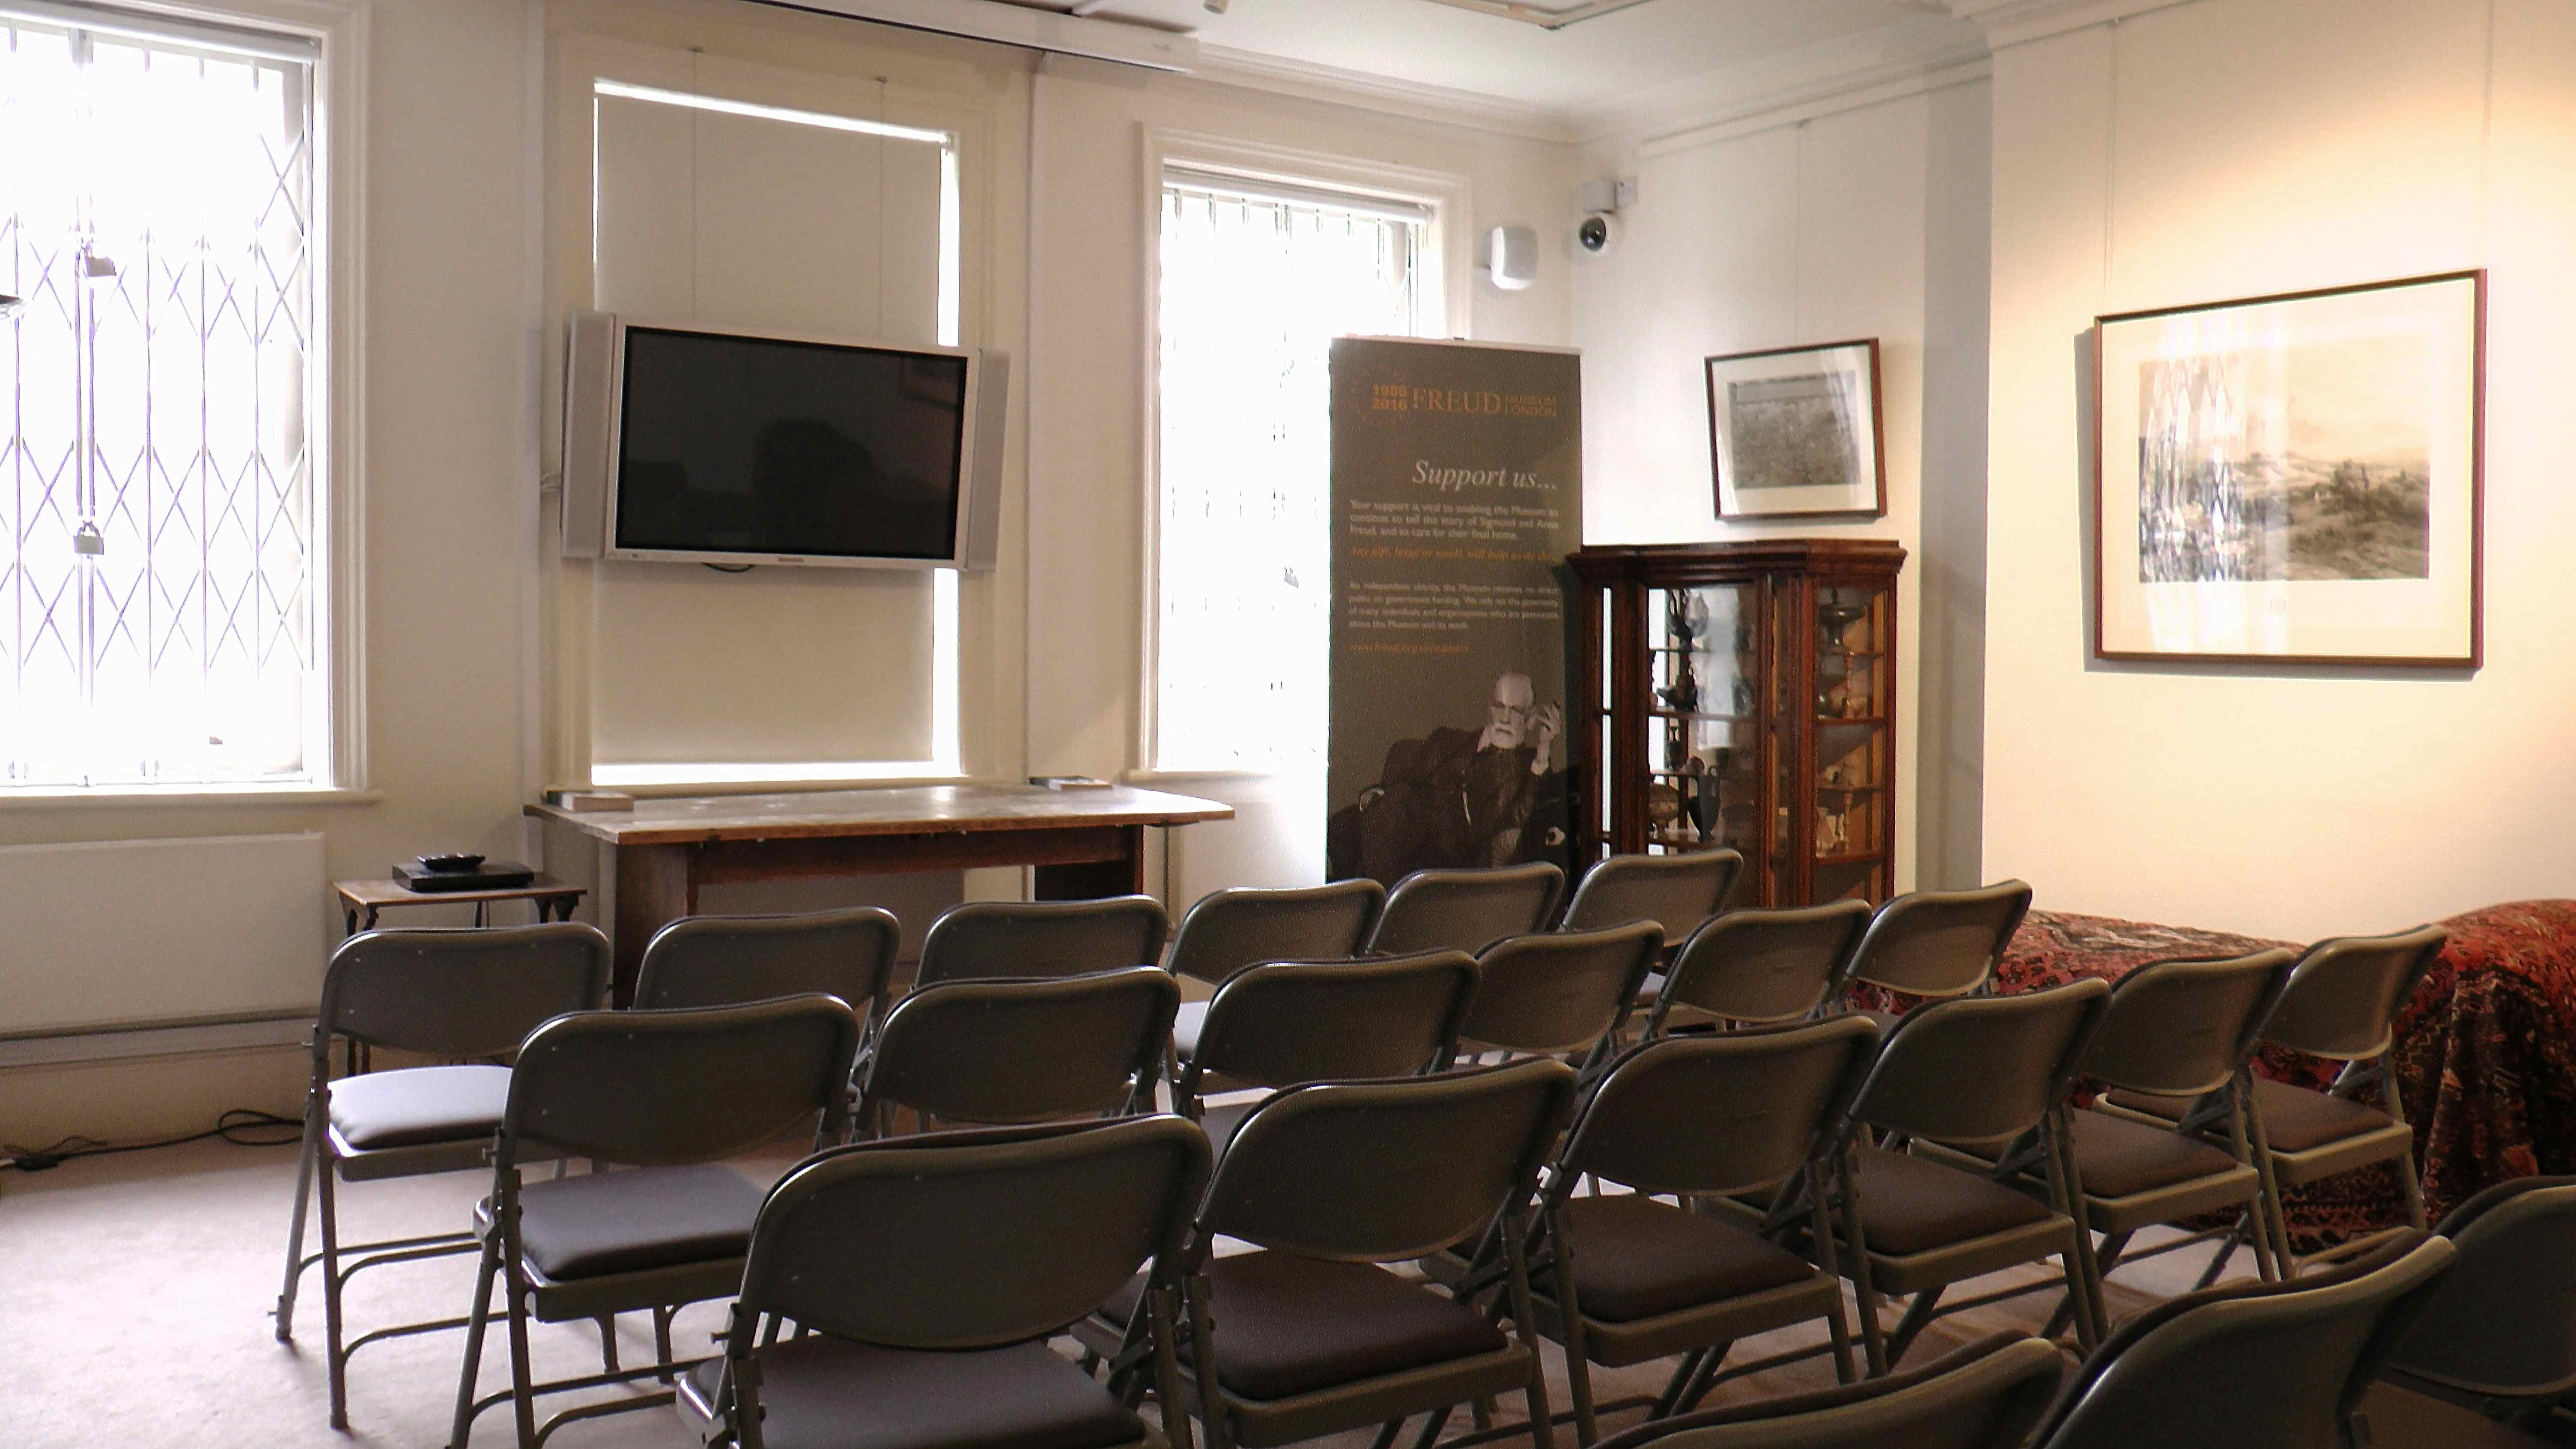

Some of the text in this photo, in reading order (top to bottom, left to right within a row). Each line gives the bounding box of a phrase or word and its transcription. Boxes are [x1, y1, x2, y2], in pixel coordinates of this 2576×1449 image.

[1371, 384, 1407, 397] 1986
[1371, 398, 1407, 411] 2016
[1412, 387, 1501, 414] FREUD
[1505, 394, 1557, 405] MUSEUM
[1505, 405, 1556, 417] LONDON
[1413, 459, 1556, 492] Support us...
